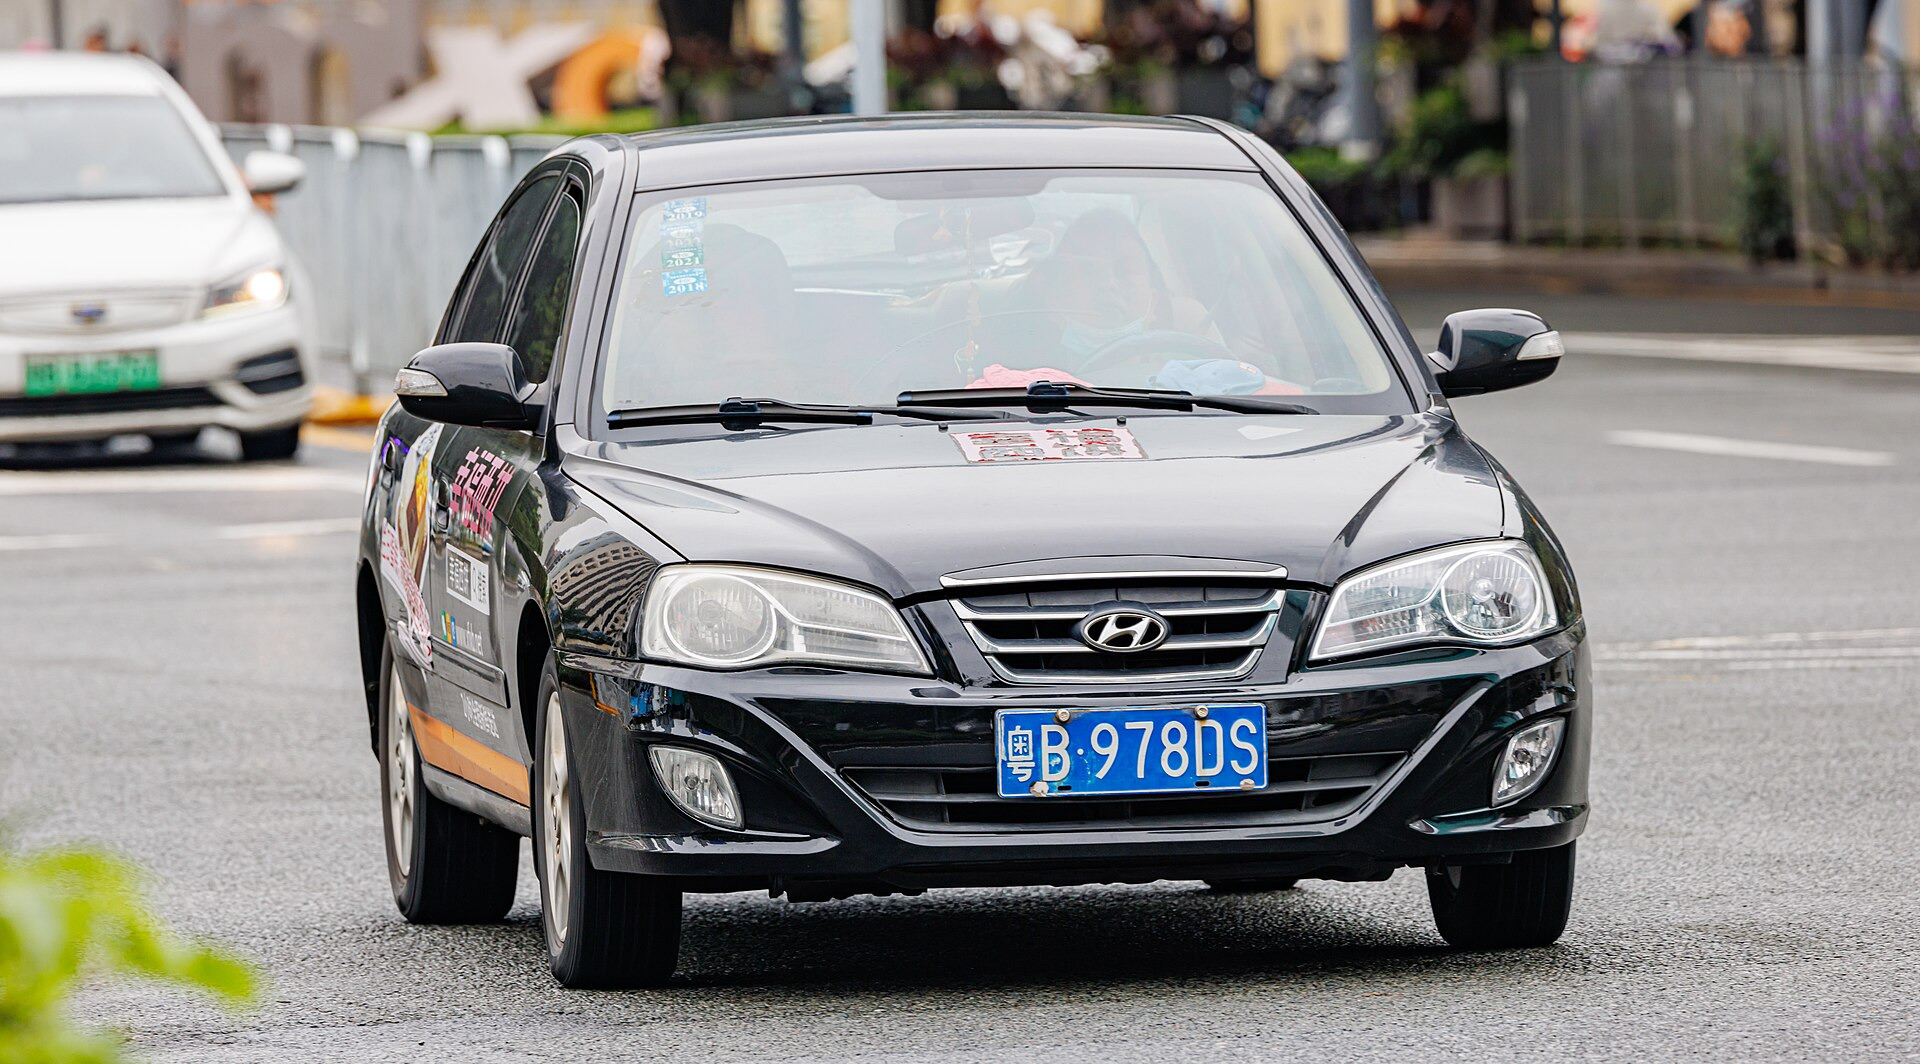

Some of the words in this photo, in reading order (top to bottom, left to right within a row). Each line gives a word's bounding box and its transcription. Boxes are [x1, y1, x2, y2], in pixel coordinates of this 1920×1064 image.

[668, 211, 703, 221] 2019
[667, 257, 700, 267] 2021
[668, 282, 704, 294] 2018
[1006, 718, 1259, 783] 粤B·978DS
